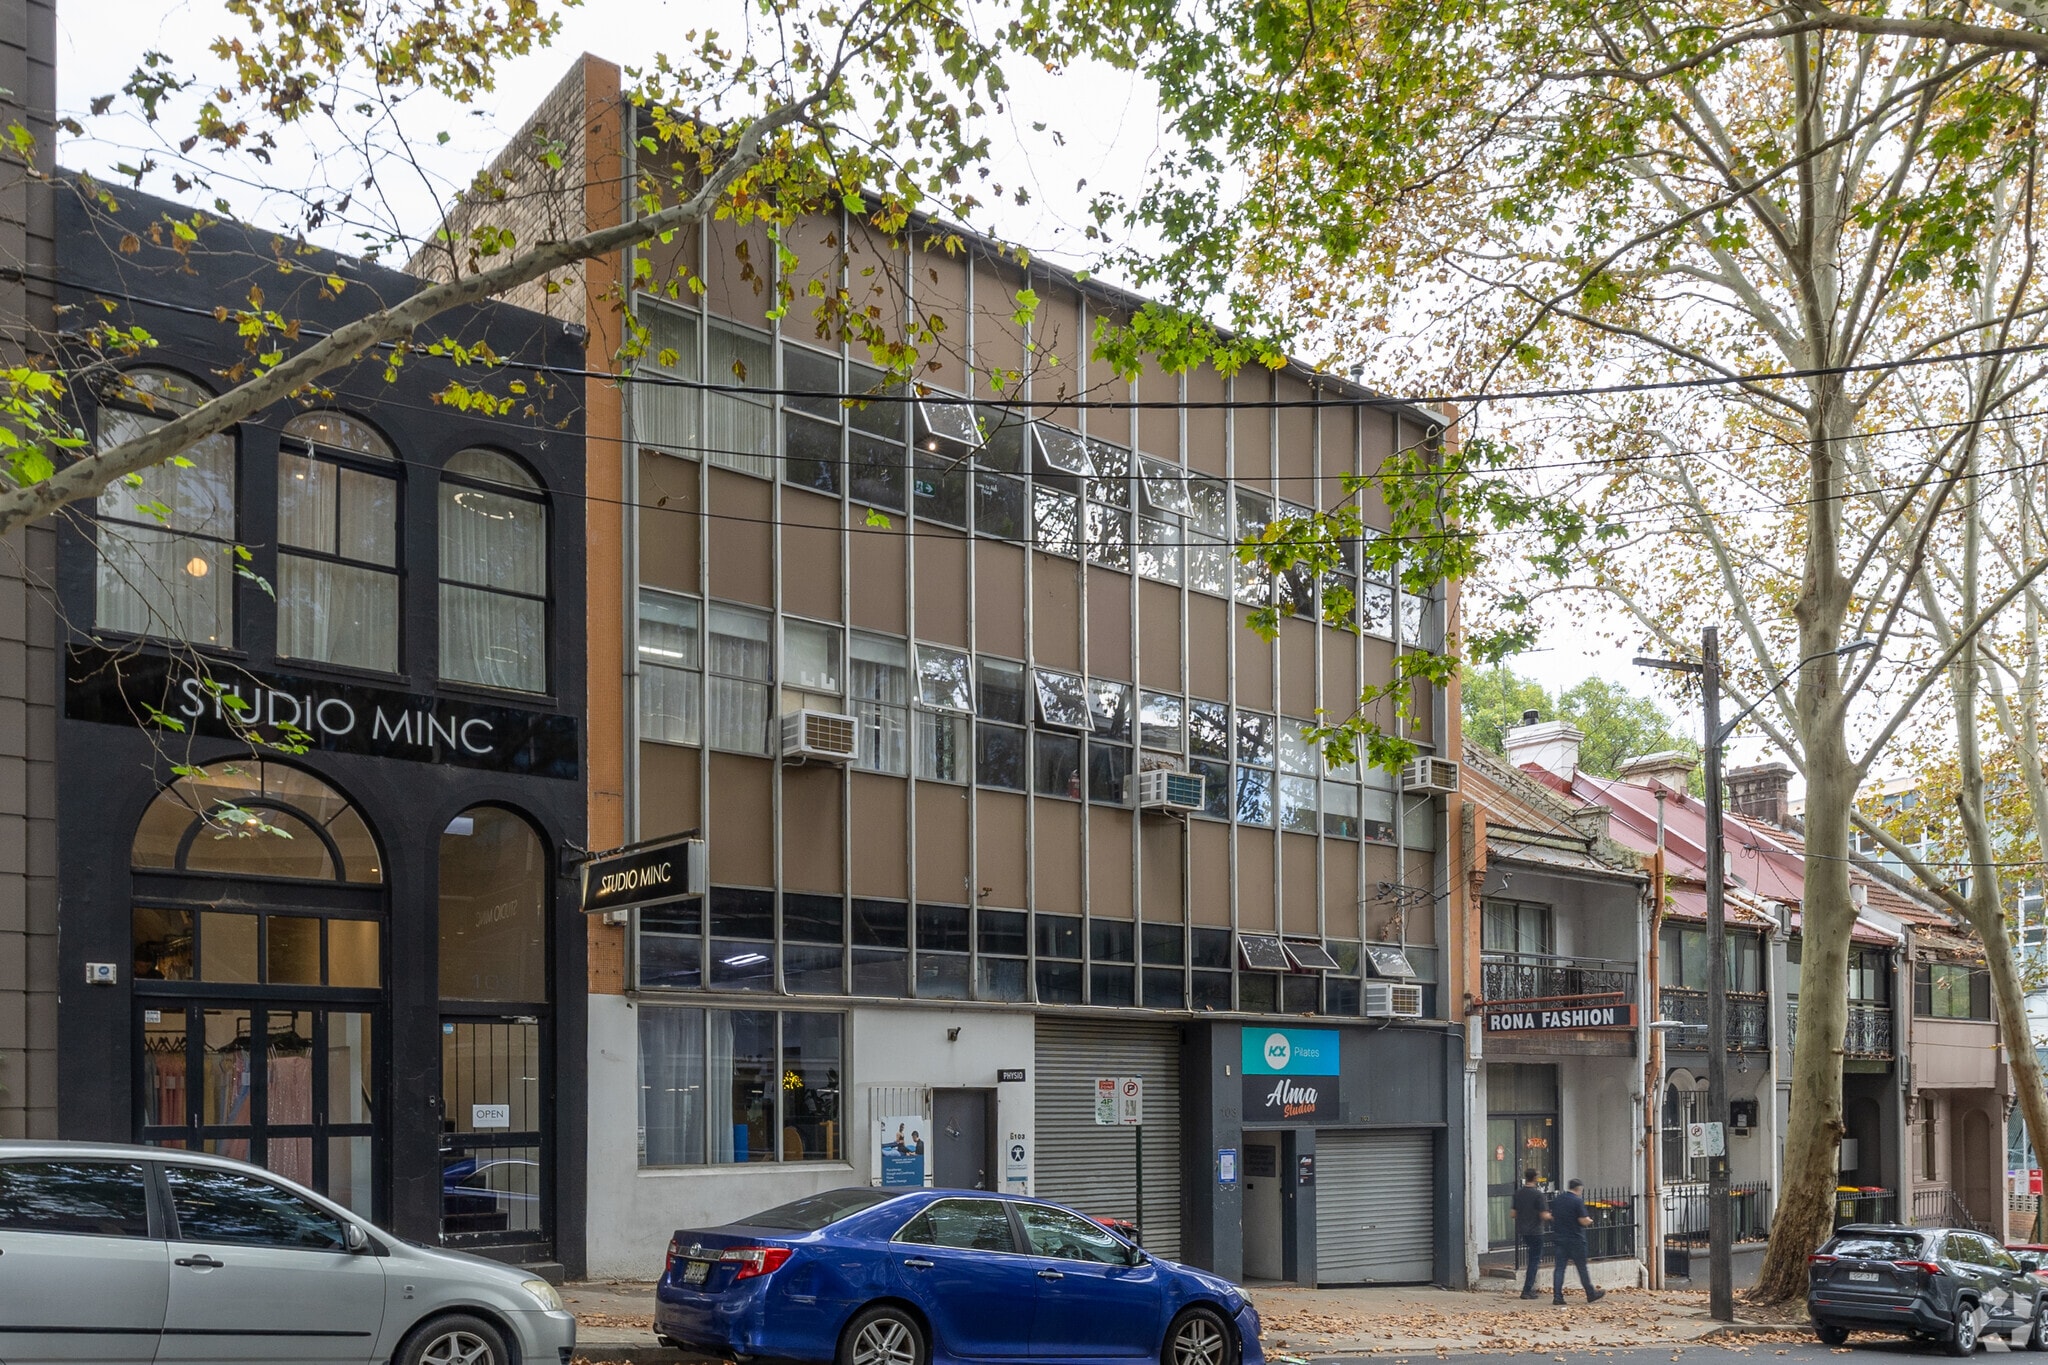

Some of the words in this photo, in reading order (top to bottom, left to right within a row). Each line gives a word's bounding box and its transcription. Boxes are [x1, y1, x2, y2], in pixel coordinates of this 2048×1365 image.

[179, 677, 355, 735] STUDIO
[372, 705, 494, 754] MINC
[601, 869, 638, 892] STUDIO
[640, 862, 671, 887] MINC
[1490, 1013, 1535, 1031] RONA
[1541, 1008, 1615, 1028] FASHION
[1268, 1046, 1286, 1058] KX
[1294, 1046, 1320, 1058] Pilates
[1003, 1071, 1024, 1081] PHYSIO
[1265, 1078, 1319, 1108] Alma
[476, 1110, 504, 1118] OPEN
[1283, 1103, 1316, 1118] Studios
